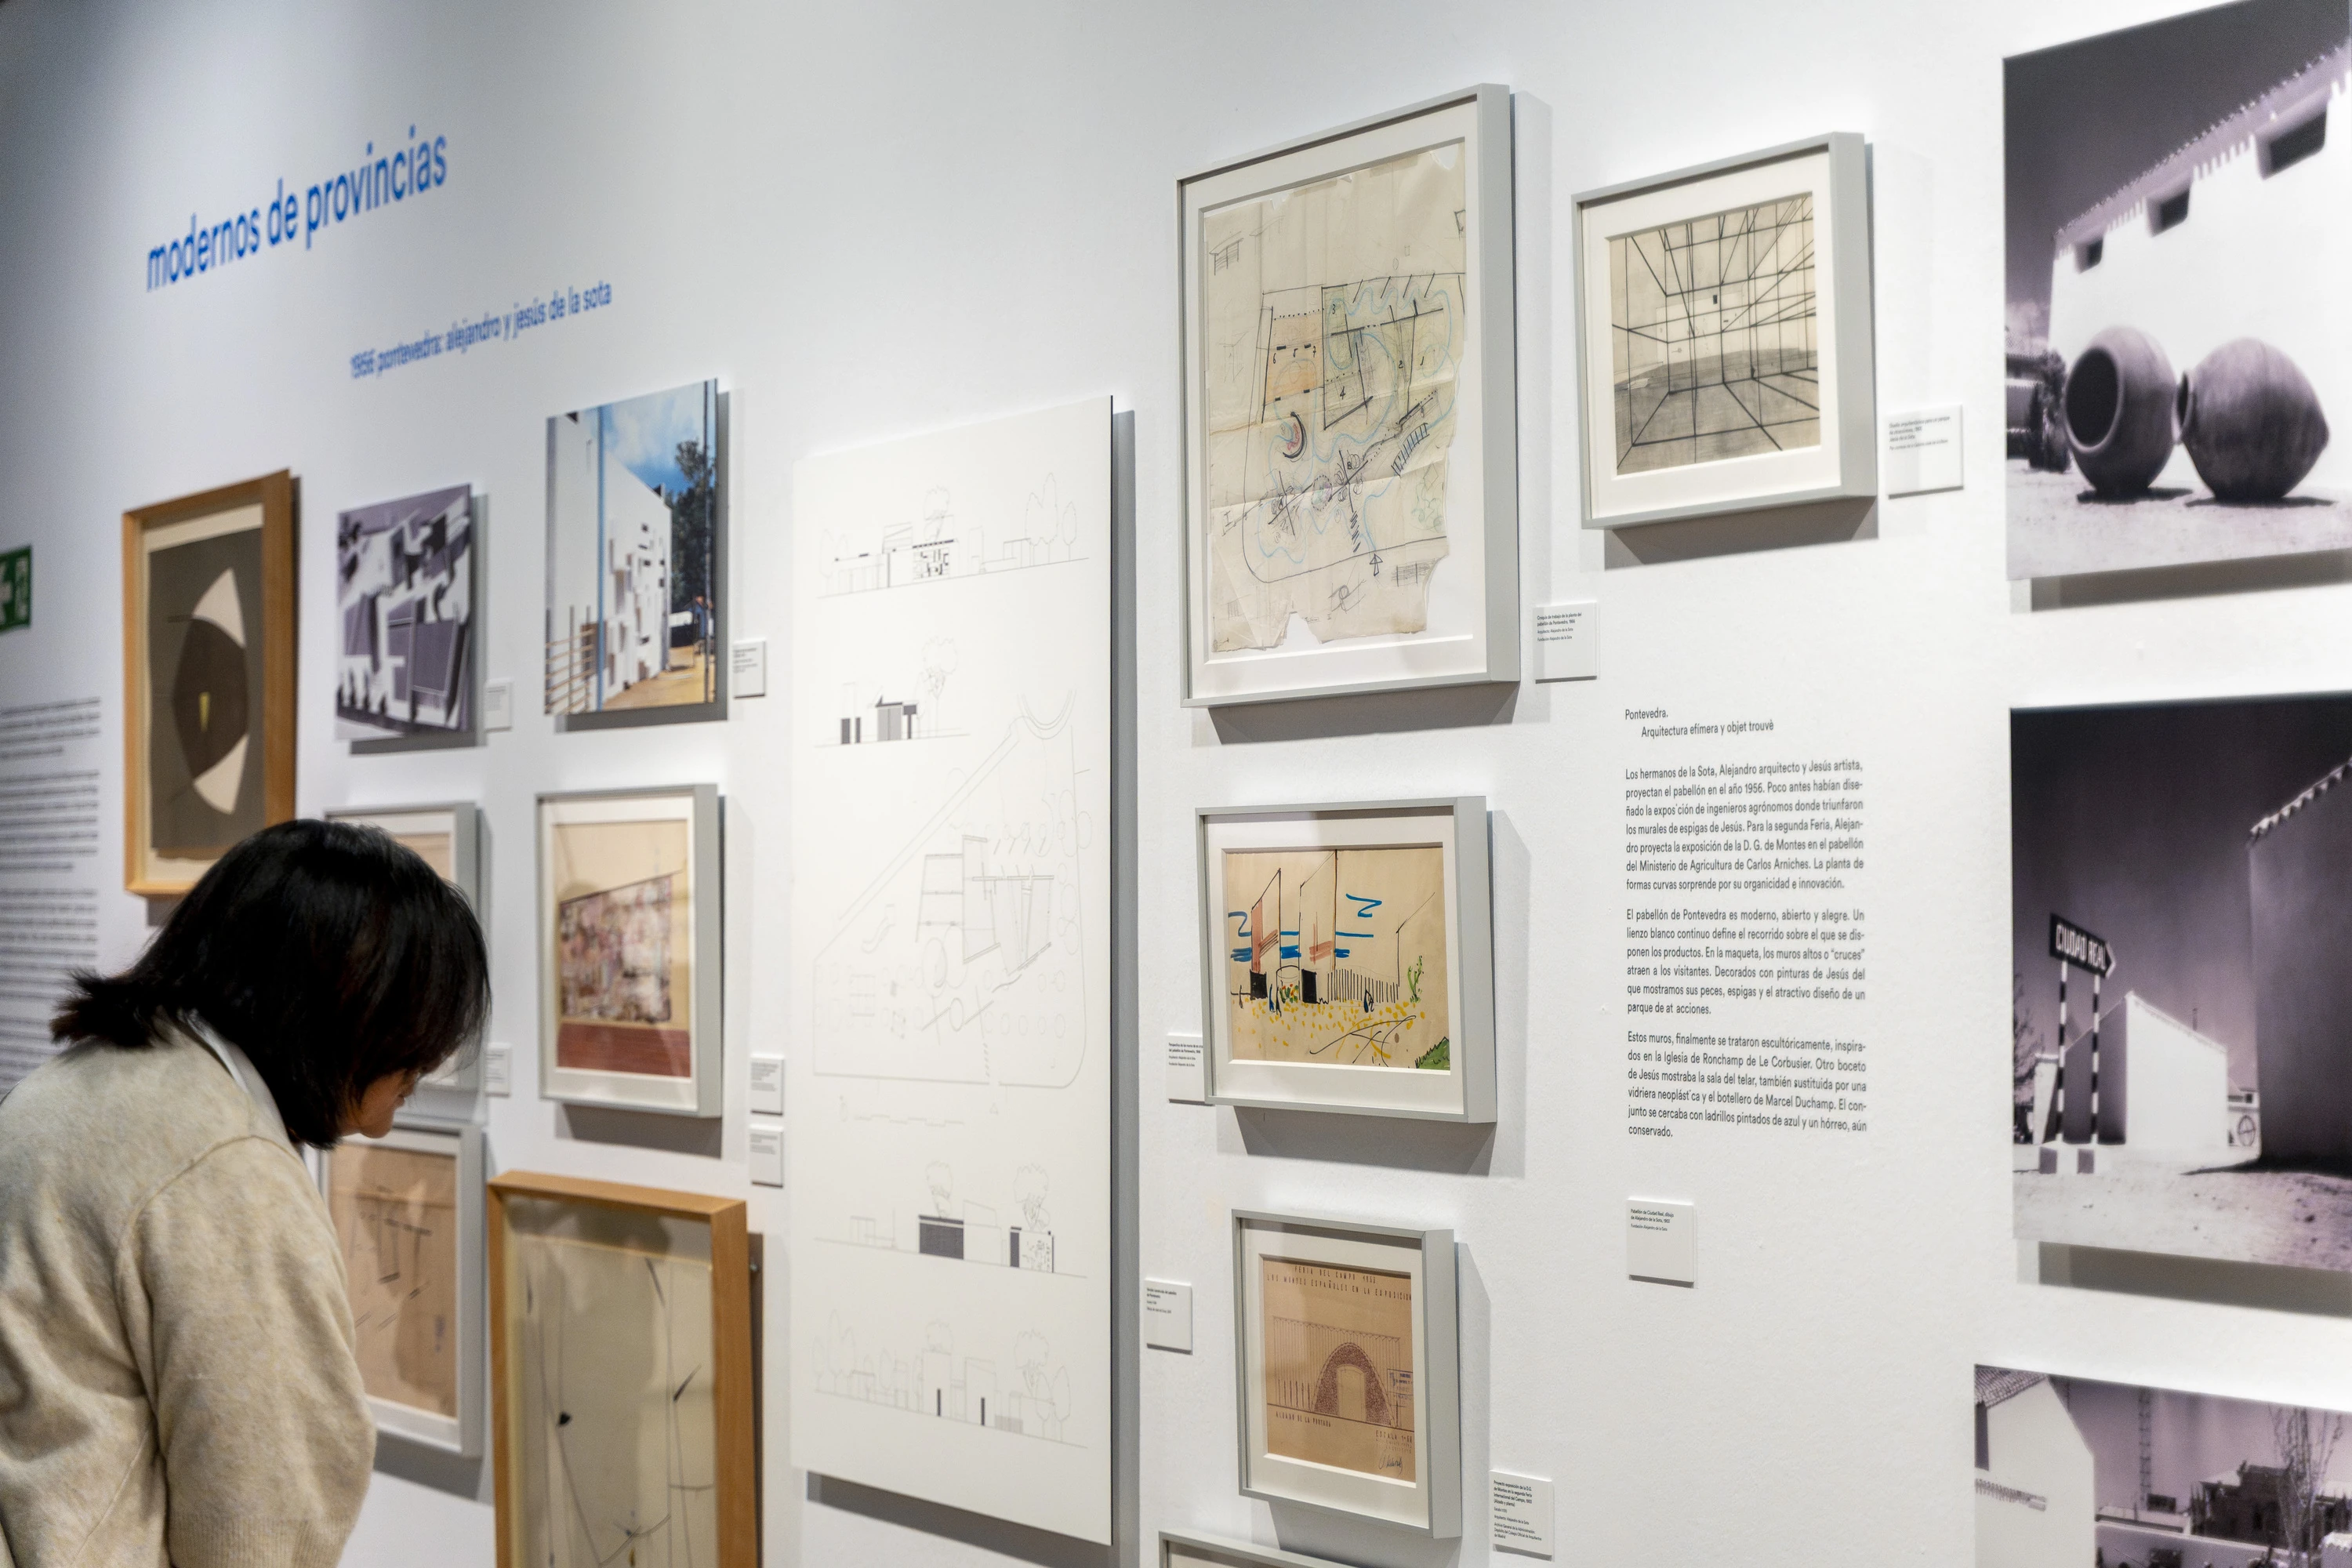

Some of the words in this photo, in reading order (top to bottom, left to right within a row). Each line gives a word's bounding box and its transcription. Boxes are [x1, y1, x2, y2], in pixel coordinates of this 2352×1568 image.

[147, 212, 261, 292] modernos
[267, 177, 299, 247] de
[305, 123, 447, 250] provincias
[445, 312, 501, 354] alejandro
[502, 314, 511, 340] y
[549, 290, 565, 320] de
[568, 285, 580, 316] la
[583, 280, 612, 311] sota
[1340, 387, 1345, 399] 4
[1625, 707, 1668, 720] Pontevedra.
[1642, 725, 1688, 739] Arquitectura
[1690, 723, 1719, 735] efímera
[1720, 724, 1725, 735] y
[1727, 720, 1747, 735] objet
[1626, 769, 1638, 779] Los
[1640, 768, 1676, 779] hermanos
[1678, 766, 1687, 778] de
[1690, 766, 1696, 777] la
[1697, 765, 1717, 778] Sota,
[1719, 763, 1757, 778] Alejandro
[1759, 762, 1800, 776] arquitecto
[1802, 764, 1807, 775] y
[1809, 760, 1831, 771] Jesús
[1834, 759, 1863, 771] artista,
[1626, 787, 1662, 800] proyectan
[1664, 785, 1671, 797] el
[1673, 784, 1705, 799] pabellón
[1708, 786, 1717, 795] en
[1719, 783, 1726, 795] el
[1728, 783, 1743, 794] año
[1744, 782, 1765, 793] 1956.
[1767, 782, 1787, 793] Poco
[1789, 782, 1811, 793] antes
[1813, 779, 1840, 791] habían
[1626, 804, 1644, 816] ñado
[1646, 804, 1652, 815] la
[1695, 803, 1704, 815] de
[1707, 801, 1747, 816] ingenieros
[1748, 801, 1793, 816] agrónomos
[1795, 800, 1820, 811] donde
[1822, 798, 1863, 811] triunfaron
[1626, 824, 1636, 835] los
[1638, 822, 1667, 834] murales
[1668, 822, 1678, 833] de
[1679, 822, 1708, 836] espigas
[1709, 821, 1719, 833] de
[1721, 821, 1744, 833] Jesús.
[1747, 820, 1764, 832] Para
[1766, 820, 1773, 831] la
[1774, 819, 1808, 833] segunda
[1810, 818, 1832, 832] Feria,
[1626, 842, 1639, 853] dro
[1640, 842, 1671, 855] proyecta
[1674, 840, 1680, 852] la
[1682, 840, 1722, 855] exposición
[1723, 840, 1733, 851] de
[1735, 840, 1741, 851] la
[1744, 840, 1751, 851] D.
[1753, 839, 1762, 851] G.
[1764, 839, 1774, 851] de
[1777, 839, 1806, 850] Montes
[1808, 841, 1817, 850] en
[1820, 838, 1827, 850] el
[1828, 837, 1864, 852] pabellón
[1626, 860, 1637, 872] del
[1639, 859, 1676, 871] Ministerio
[1679, 859, 1688, 871] de
[1690, 859, 1732, 873] Agricultura
[1734, 858, 1744, 870] de
[1747, 858, 1771, 870] Carlos
[1773, 858, 1811, 869] Arniches.
[1814, 858, 1823, 869] La
[1826, 858, 1850, 872] planta
[1853, 857, 1864, 869] de
[1626, 879, 1651, 890] formas
[1653, 881, 1677, 890] curvas
[1679, 878, 1716, 892] sorprende
[1719, 881, 1731, 892] por
[1733, 880, 1742, 889] su
[1744, 877, 1790, 892] organicidad
[1798, 877, 1844, 889] innovación.
[1628, 1031, 1647, 1043] Estos
[1649, 1035, 1674, 1046] muros,
[1675, 1033, 1715, 1045] finalmente
[1718, 1037, 1726, 1046] se
[1728, 1036, 1759, 1047] trataron
[1762, 1036, 1833, 1052] escultóricamente,
